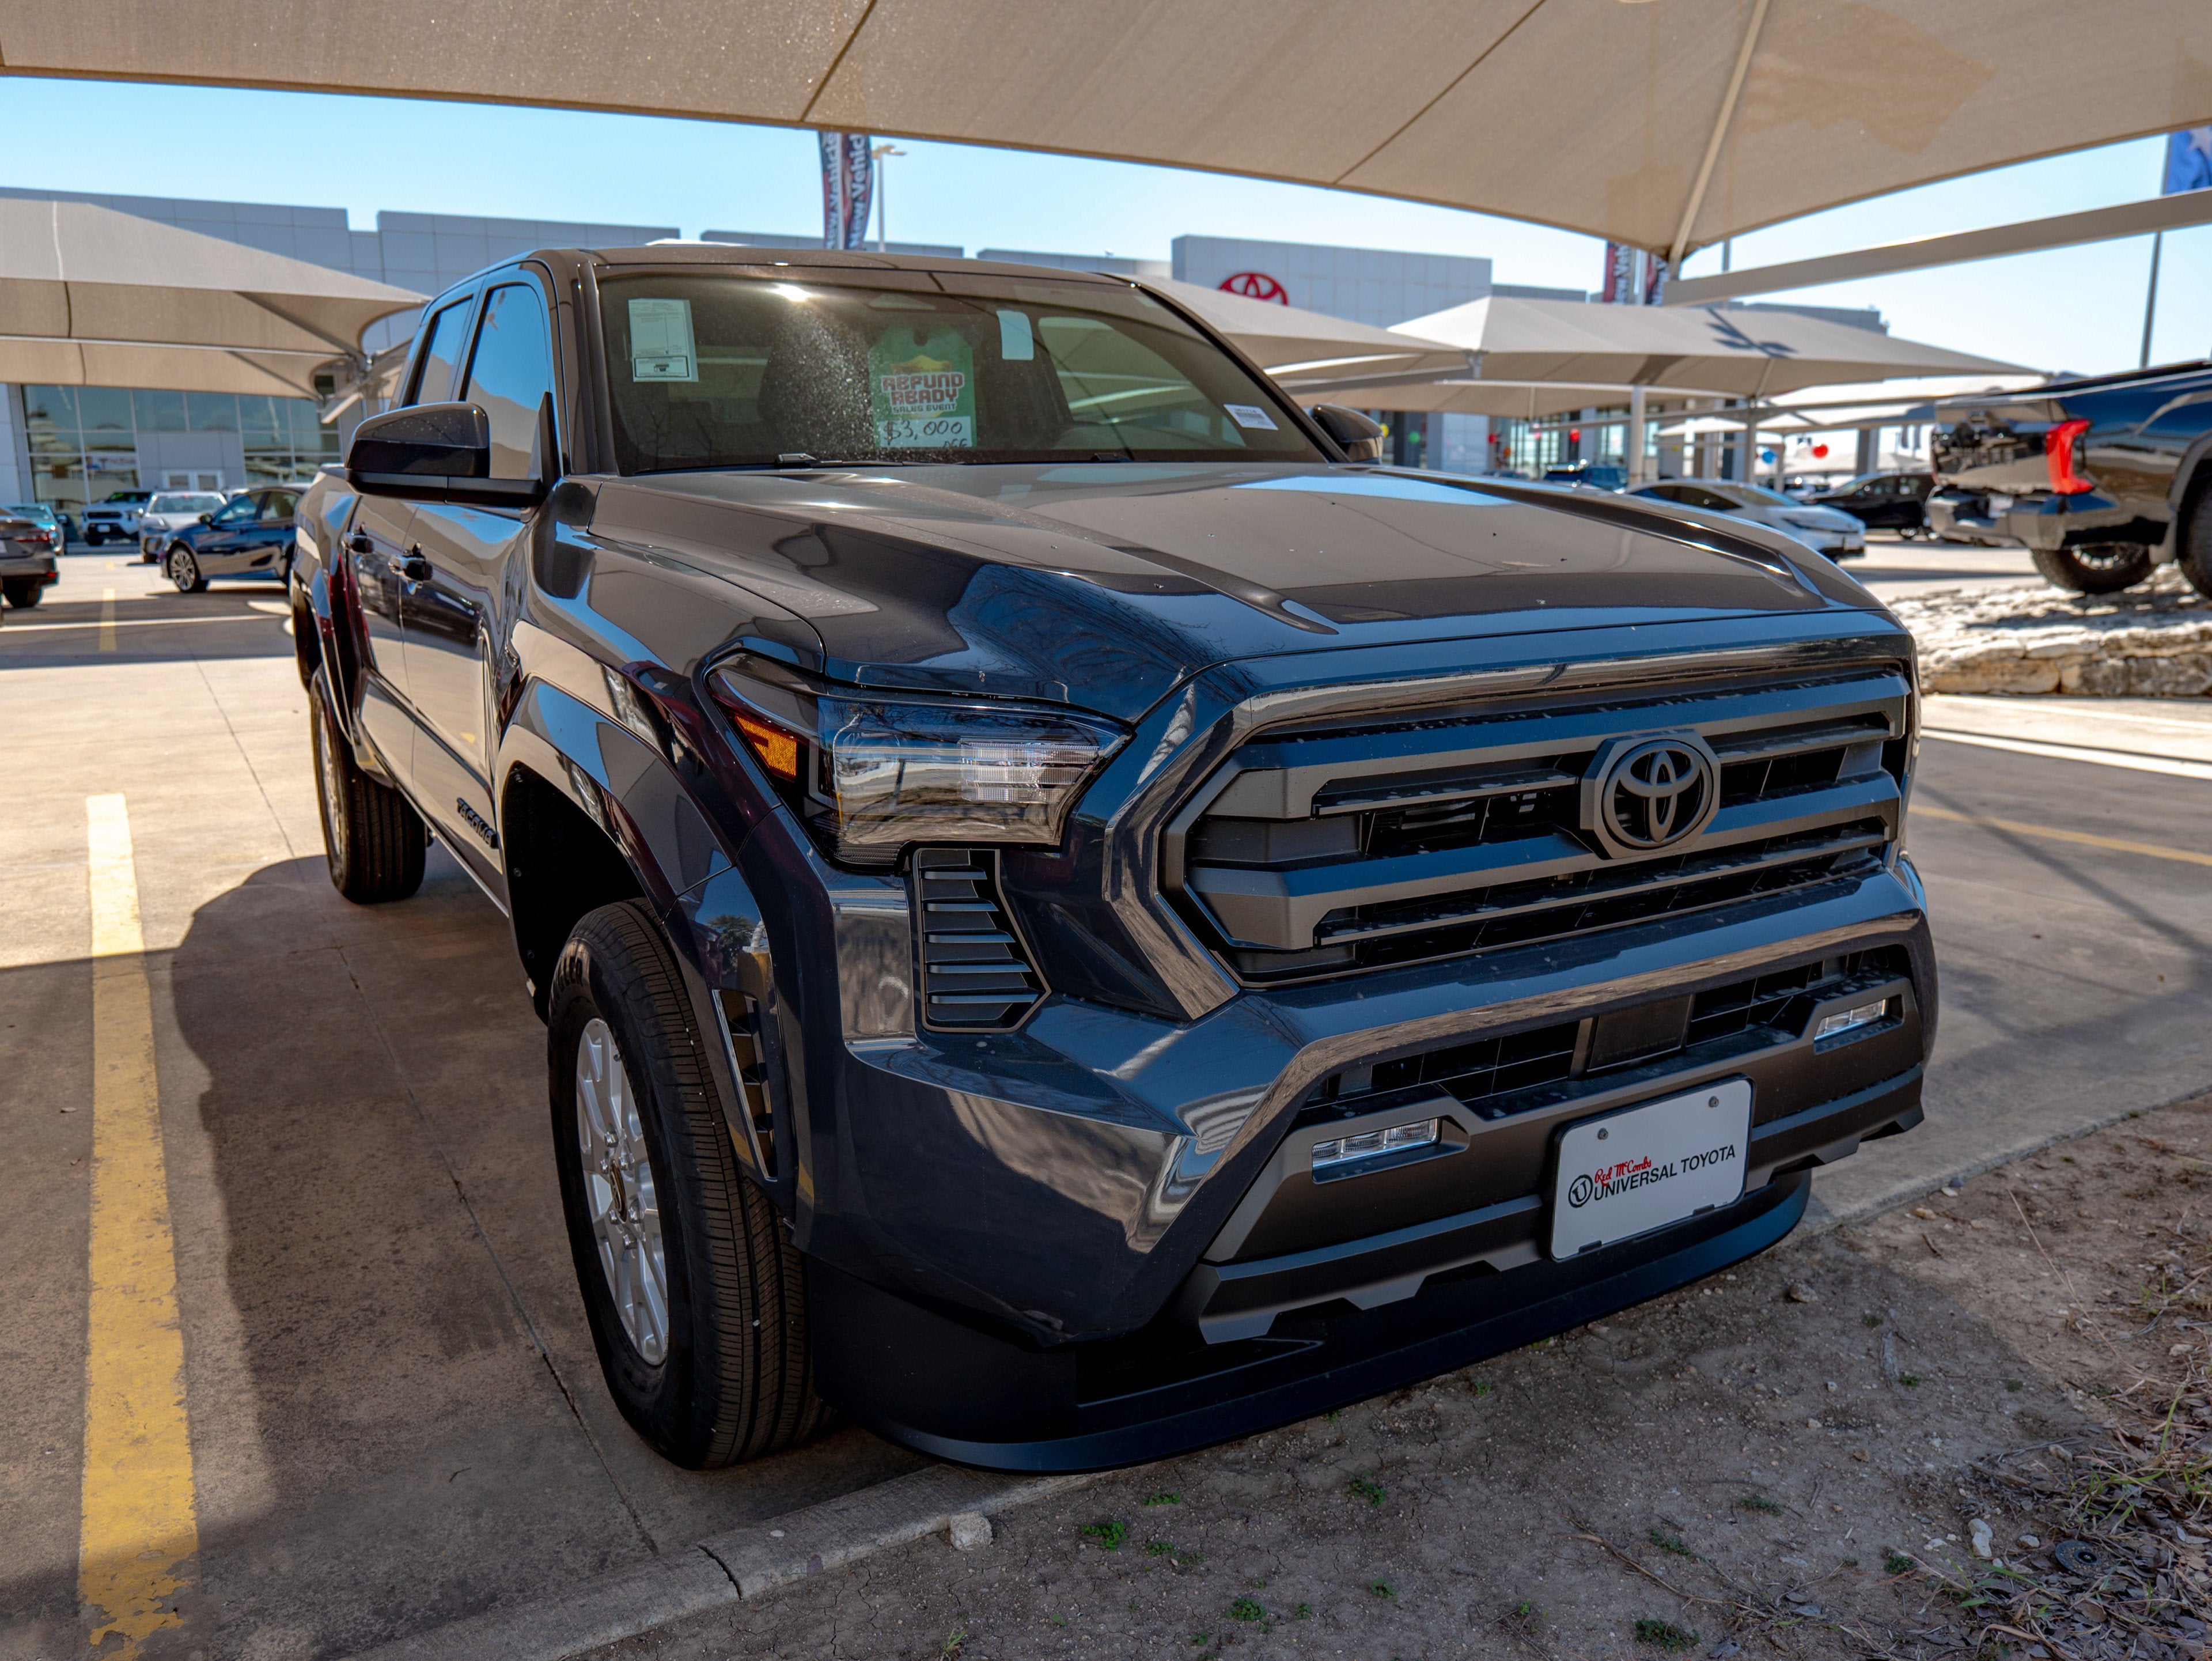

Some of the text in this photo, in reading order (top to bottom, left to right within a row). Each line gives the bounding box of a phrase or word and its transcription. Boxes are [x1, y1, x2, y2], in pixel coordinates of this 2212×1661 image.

[849, 133, 867, 199] Vehicl
[882, 372, 964, 392] REFUND
[891, 388, 957, 405] READY
[893, 403, 956, 413] SALES EVENT
[883, 419, 963, 446] $3,000
[1594, 1155, 1652, 1187] Red McCombs
[1594, 1144, 1736, 1201] UNIVERSAL TOYOTA
